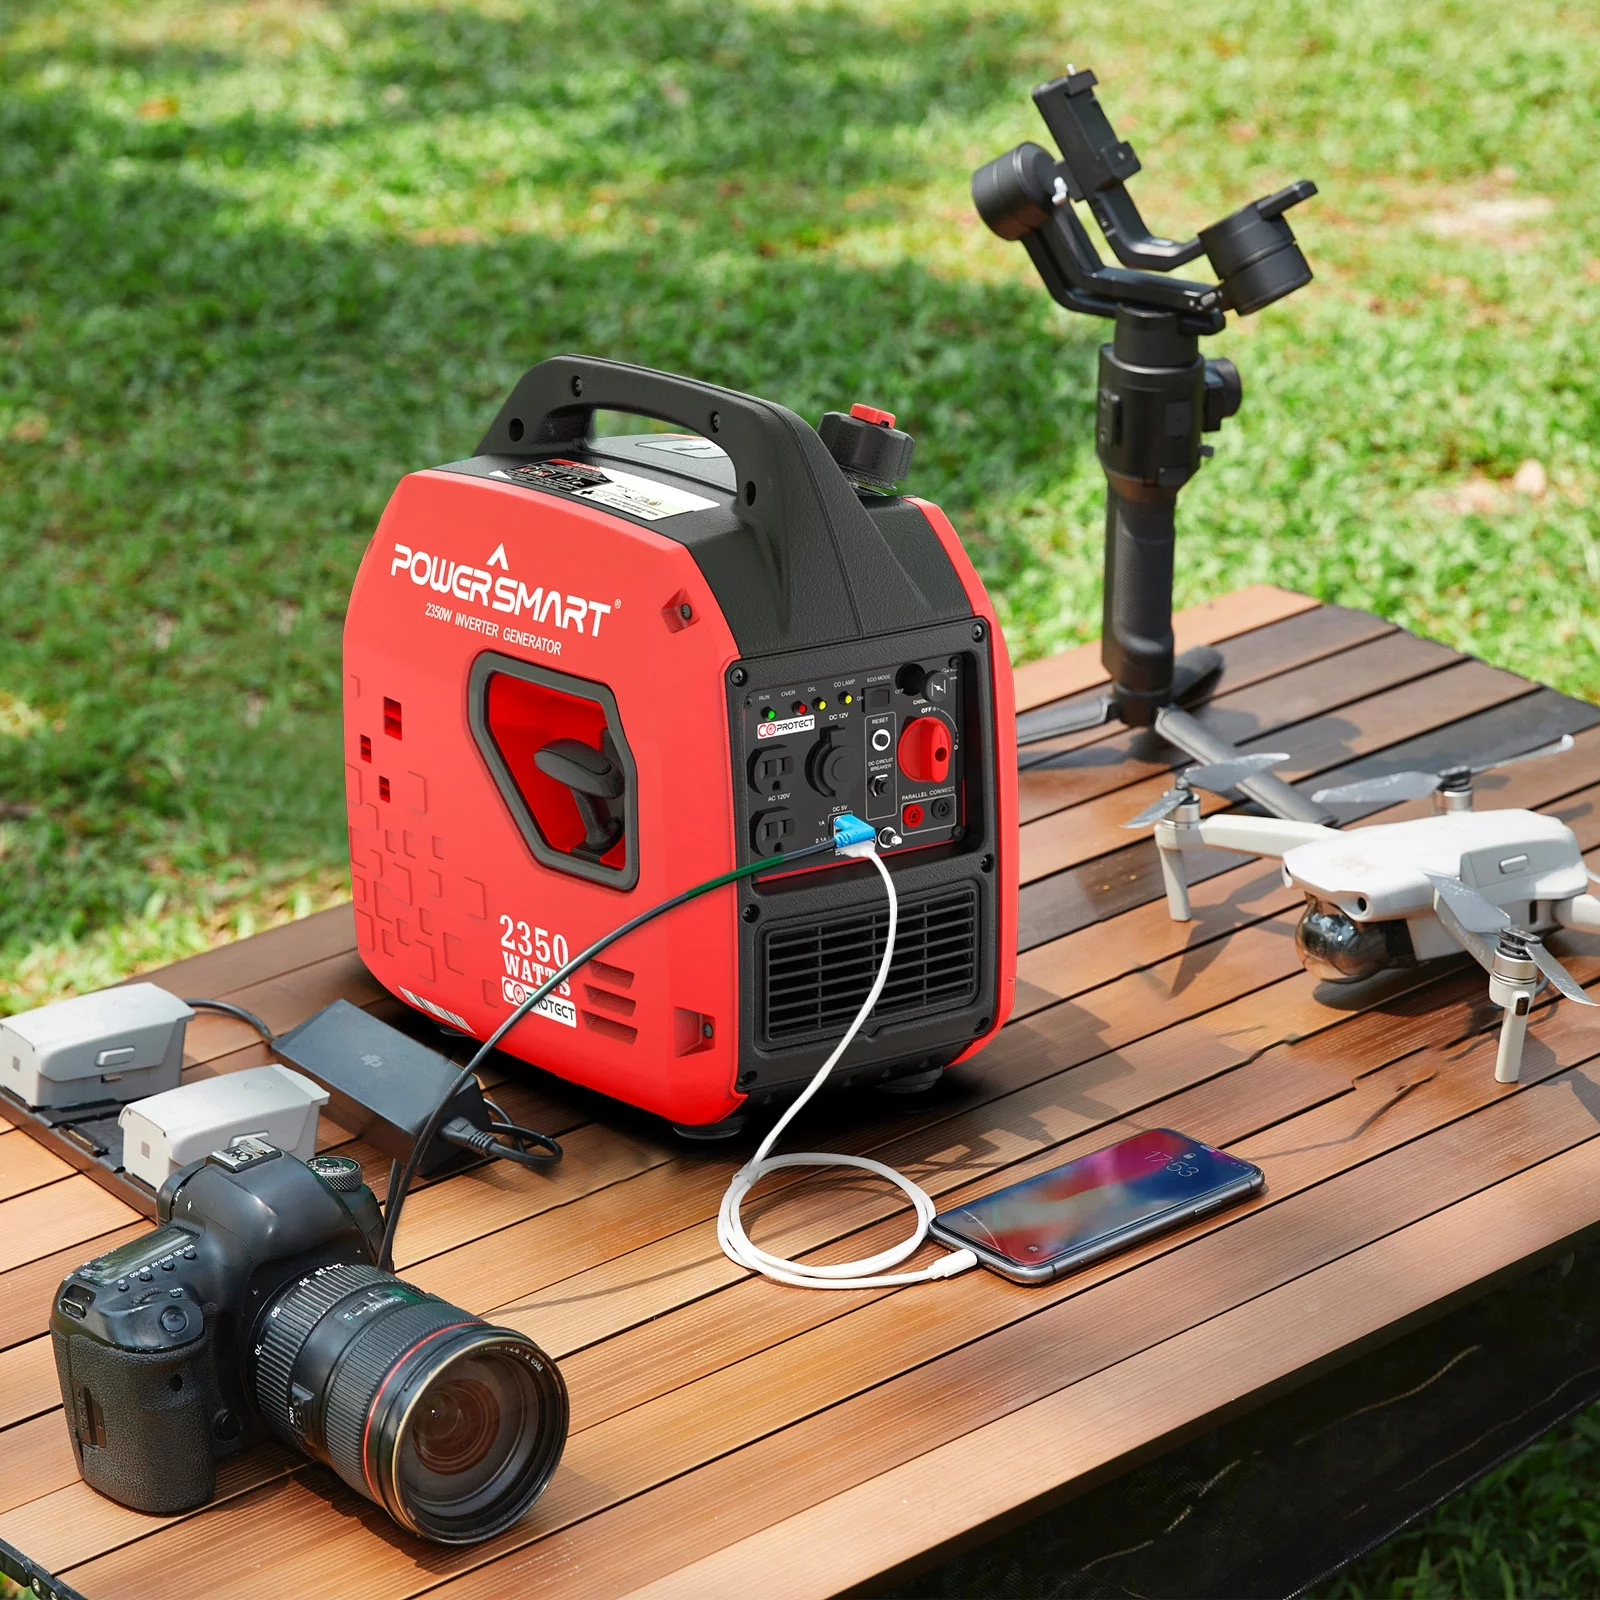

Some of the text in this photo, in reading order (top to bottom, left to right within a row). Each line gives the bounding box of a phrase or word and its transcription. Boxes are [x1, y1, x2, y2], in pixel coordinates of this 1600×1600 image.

[390, 542, 612, 637] POWERSMART
[425, 602, 562, 656] 2350W INVERTER GENERATOR
[878, 674, 891, 682] MODE
[872, 716, 888, 724] RESET
[876, 757, 894, 765] CIRCUIT
[901, 786, 955, 800] PARALLEL CONNECT
[500, 914, 568, 968] 2350
[298, 1277, 311, 1287] 35
[270, 1306, 281, 1318] 50
[254, 1343, 262, 1356] 70
[531, 1358, 544, 1372] USM
